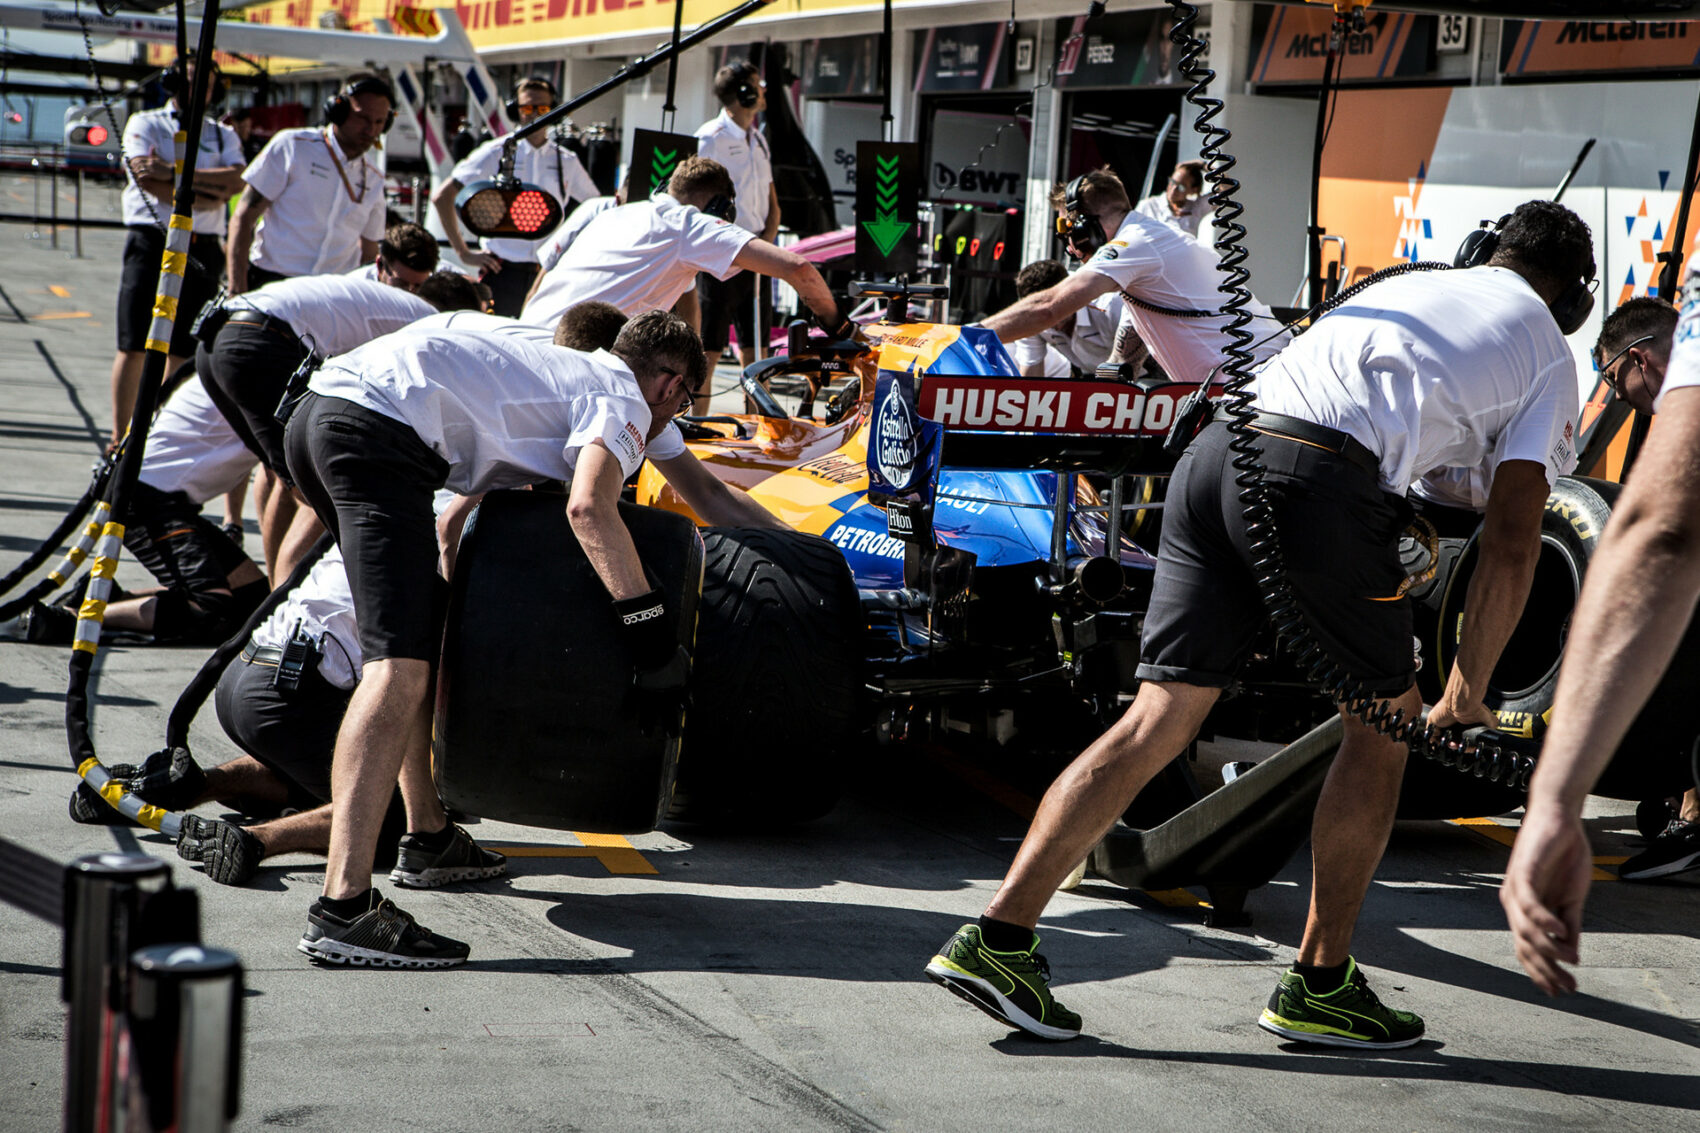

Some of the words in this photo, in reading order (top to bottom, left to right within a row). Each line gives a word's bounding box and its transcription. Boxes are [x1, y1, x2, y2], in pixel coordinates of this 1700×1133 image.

[1442, 15, 1462, 44] 35
[1555, 21, 1688, 44] McLaren
[1285, 32, 1374, 58] McLen
[834, 148, 856, 168] Sp
[959, 169, 1021, 195] BWT
[933, 388, 1071, 428] HUSKI
[881, 411, 909, 441] Estrella
[881, 437, 911, 466] Galicia
[935, 485, 991, 515] NAULT
[888, 507, 913, 529] Hiton
[1544, 492, 1593, 540] ERO
[830, 524, 906, 560] PETROBRA
